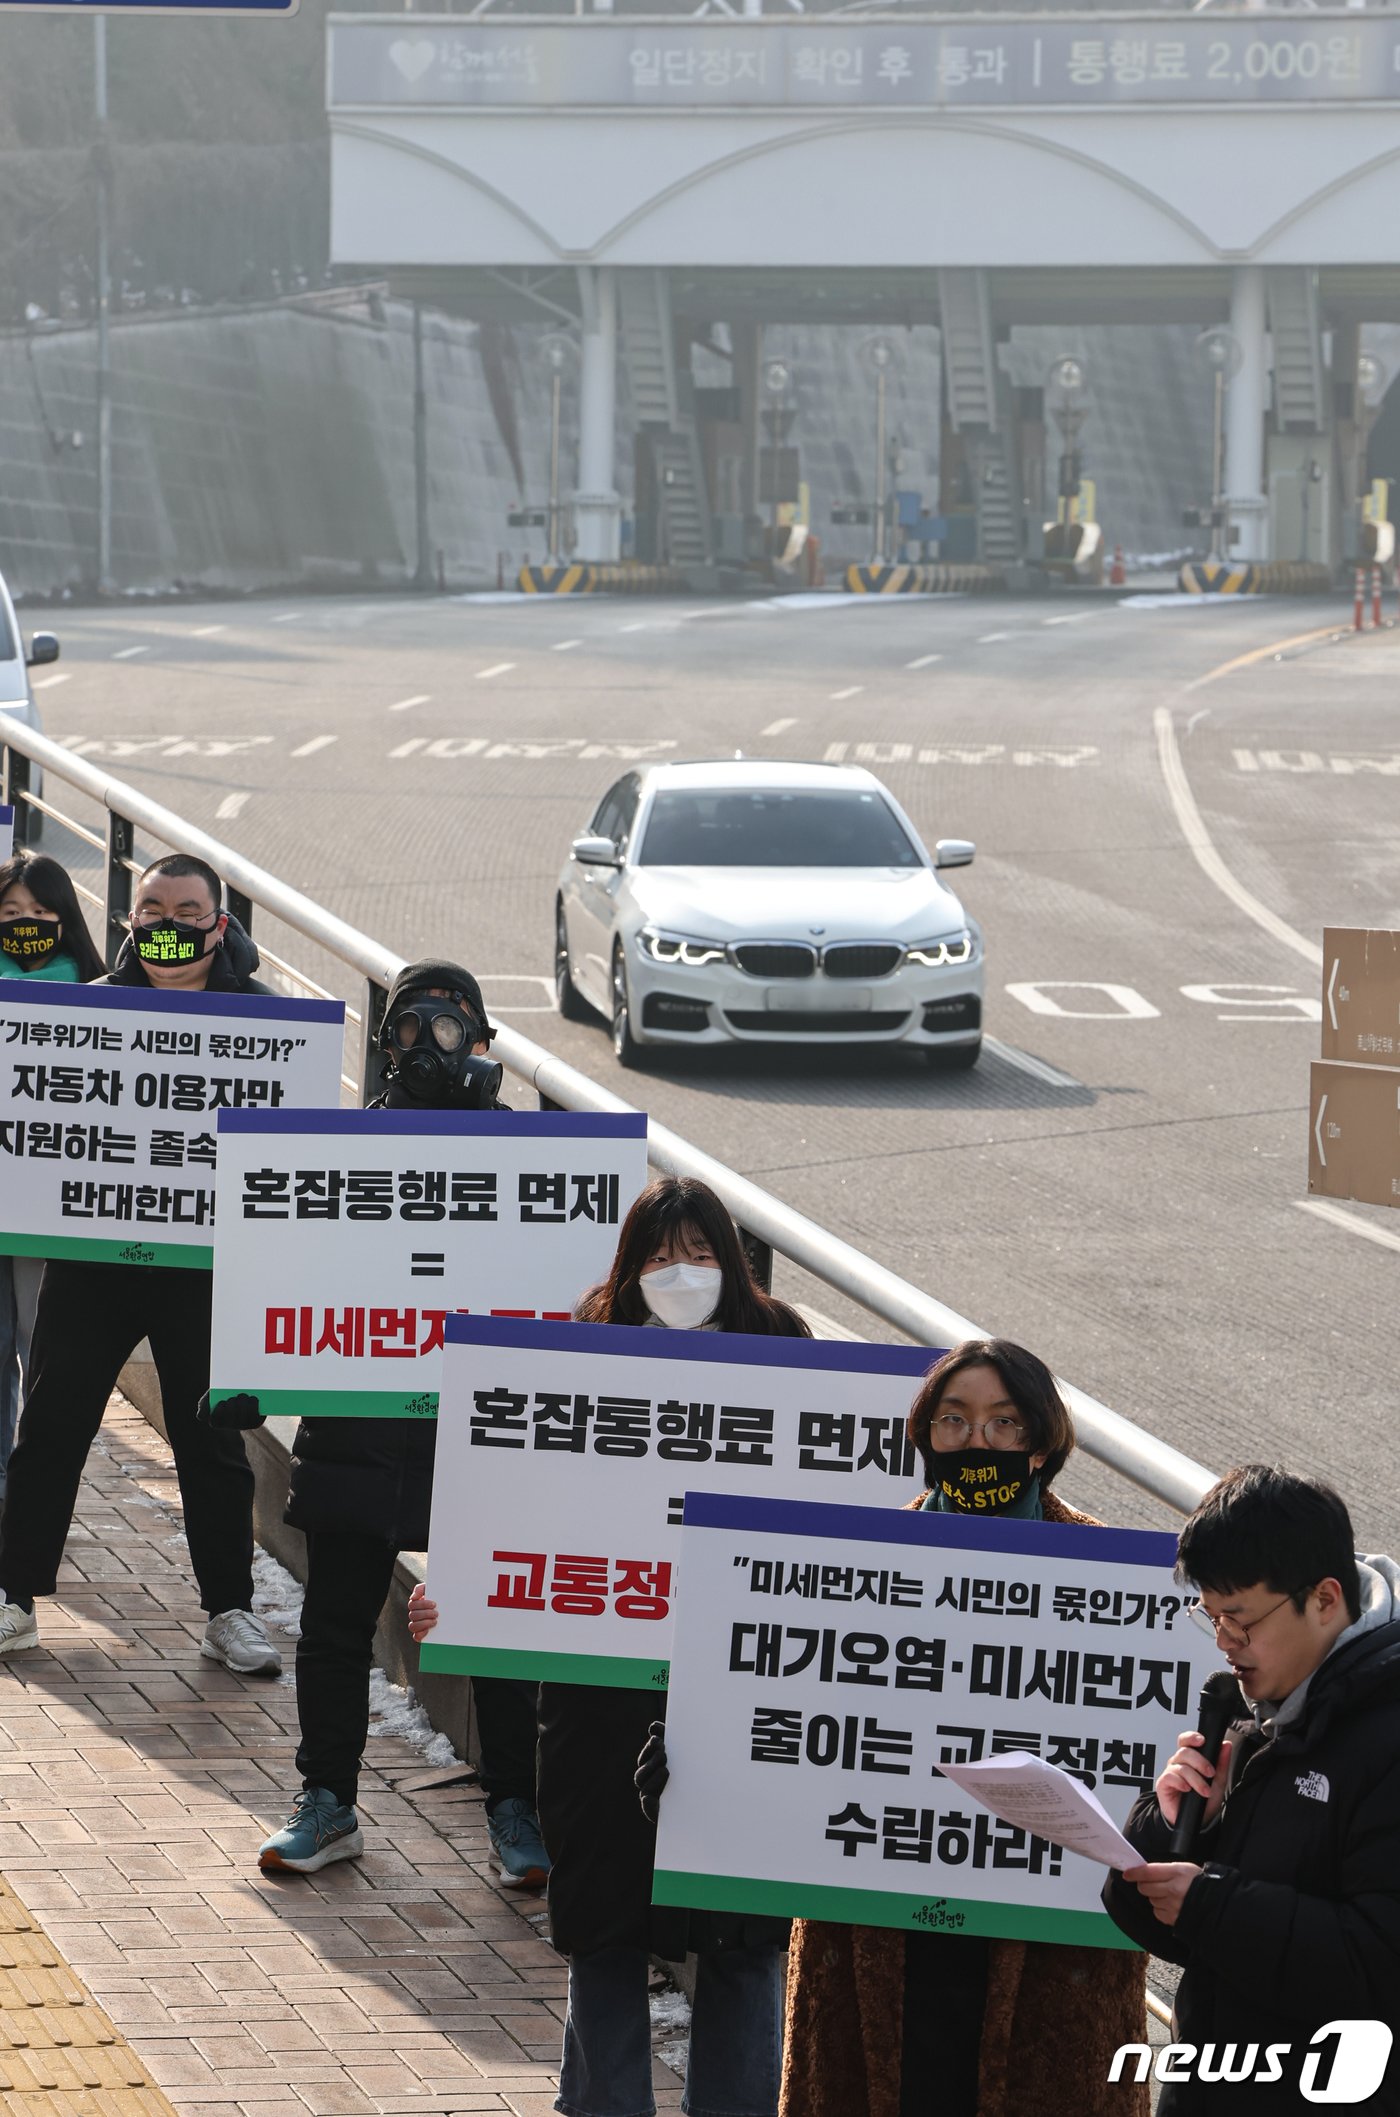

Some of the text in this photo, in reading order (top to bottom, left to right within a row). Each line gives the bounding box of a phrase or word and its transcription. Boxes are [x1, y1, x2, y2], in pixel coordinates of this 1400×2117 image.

[629, 47, 767, 87] 일단정지
[791, 47, 863, 87] 확인
[876, 46, 913, 87] 후
[936, 46, 1008, 87] 통과
[1067, 39, 1190, 85] 통행료
[1207, 36, 1362, 84] 2,000원
[13, 926, 39, 938] 기후위기
[23, 938, 54, 954] STOP
[139, 943, 194, 960] 우리는 살고 싶다
[152, 935, 177, 944] 기후위기
[130, 1029, 201, 1056] 시민의
[208, 1034, 307, 1063] 몫인가?"
[11, 1064, 124, 1107] 자동차
[0, 1119, 217, 1170] 지원하는 졸속
[242, 1168, 620, 1225] 혼잡통행료 면제
[404, 1399, 439, 1416] 서울환경연
[469, 1386, 915, 1478] 혼잡통행료 면제
[959, 1465, 999, 1485] 기후위기
[973, 1481, 1021, 1509] STOP
[487, 1550, 673, 1621] 교통정
[732, 1555, 1199, 1631] "미세먼지는 시민의 몫인가?"
[728, 1621, 1191, 1716] 대기오염·미세먼지
[750, 1706, 913, 1777] 줄이는
[824, 1801, 1064, 1877] 수립하라!
[911, 1904, 966, 1930] 서울환경연합
